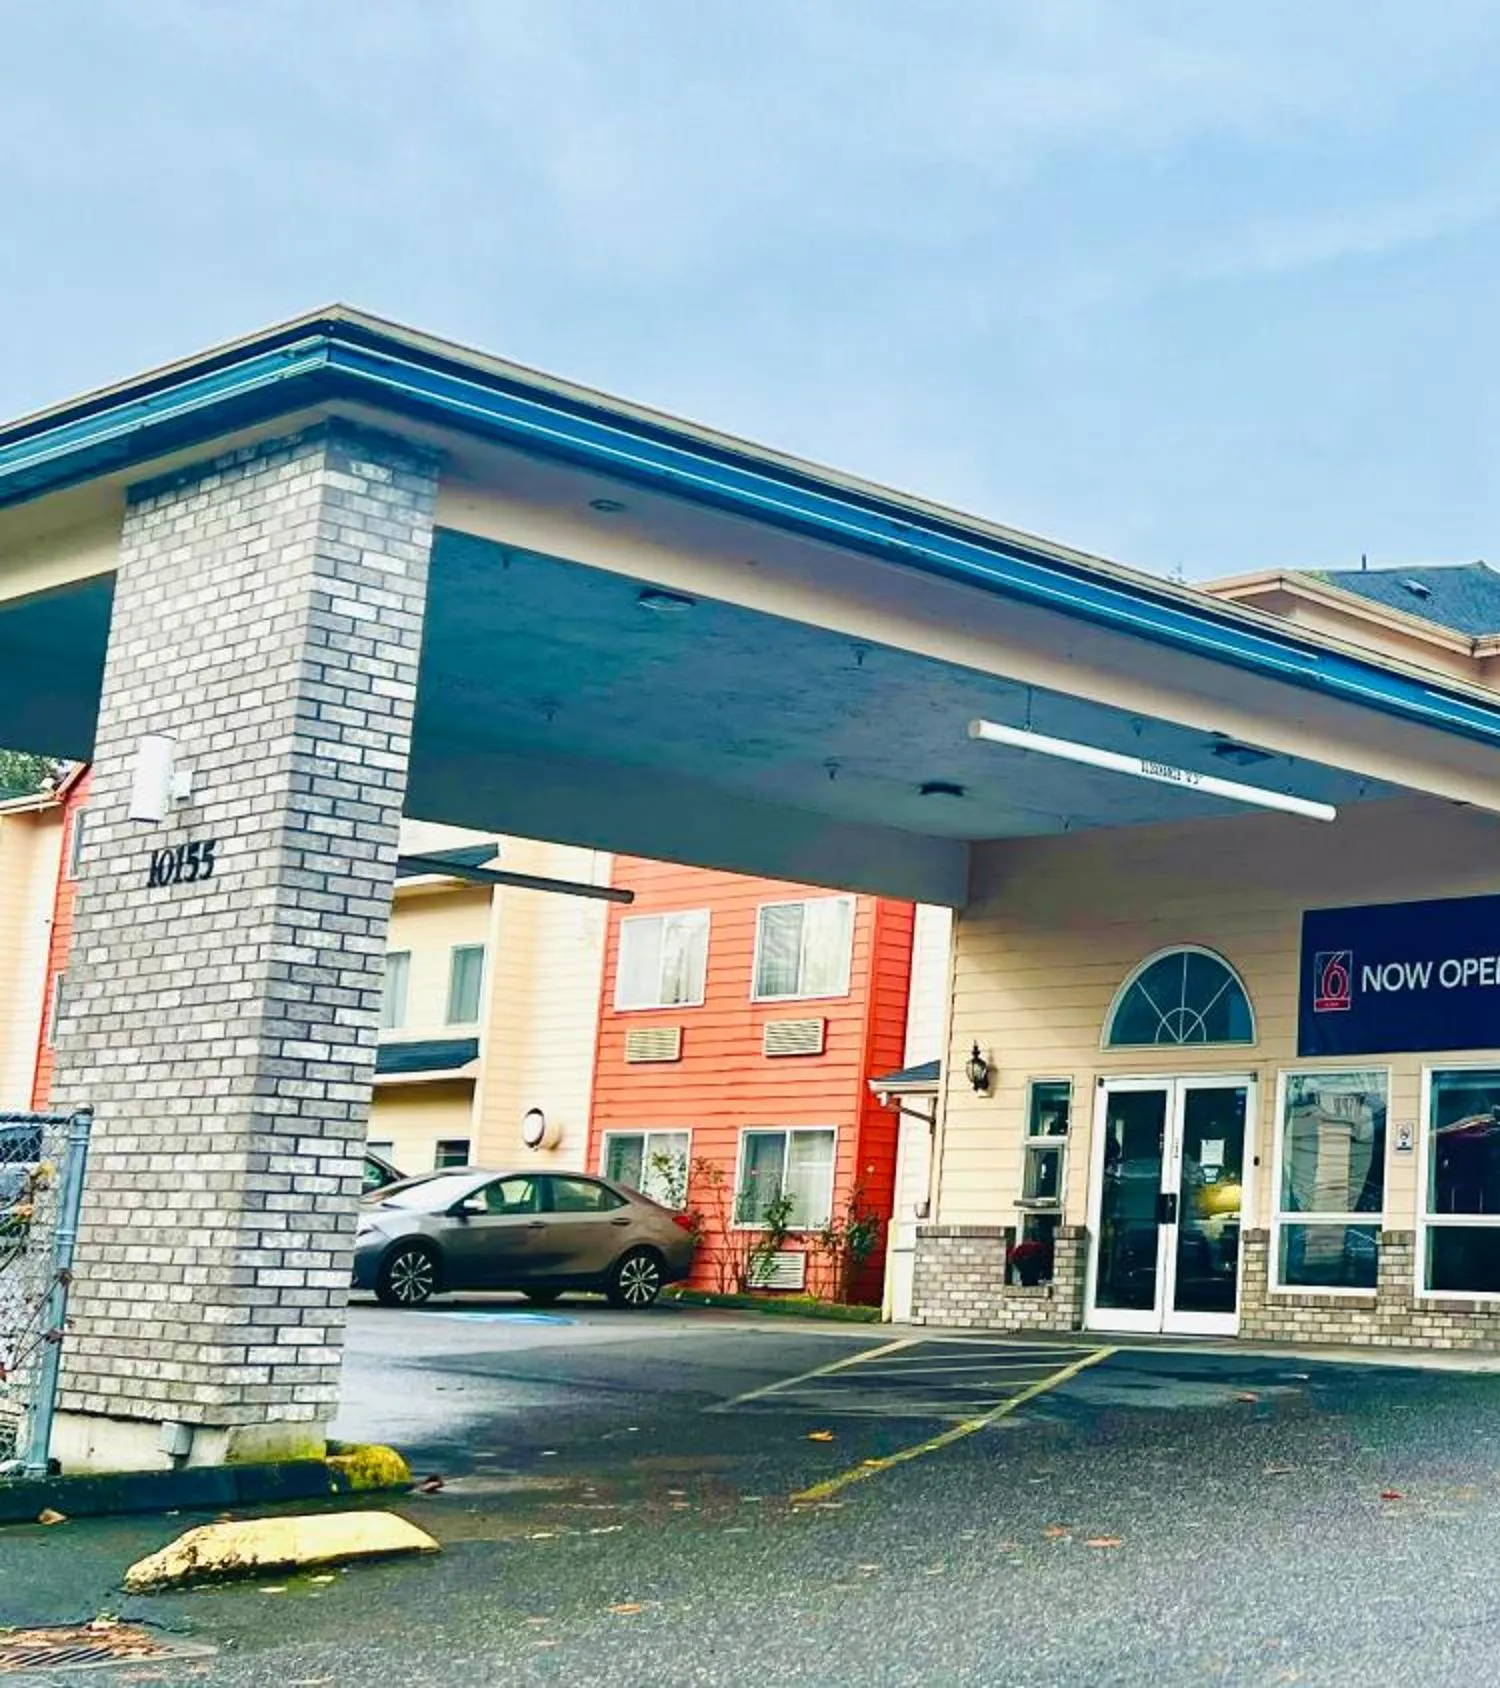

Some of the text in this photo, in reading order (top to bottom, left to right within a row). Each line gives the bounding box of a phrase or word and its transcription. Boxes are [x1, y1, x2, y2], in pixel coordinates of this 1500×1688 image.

[147, 840, 216, 888] 10155
[1321, 950, 1349, 1000] 6
[1361, 961, 1433, 993] NOW
